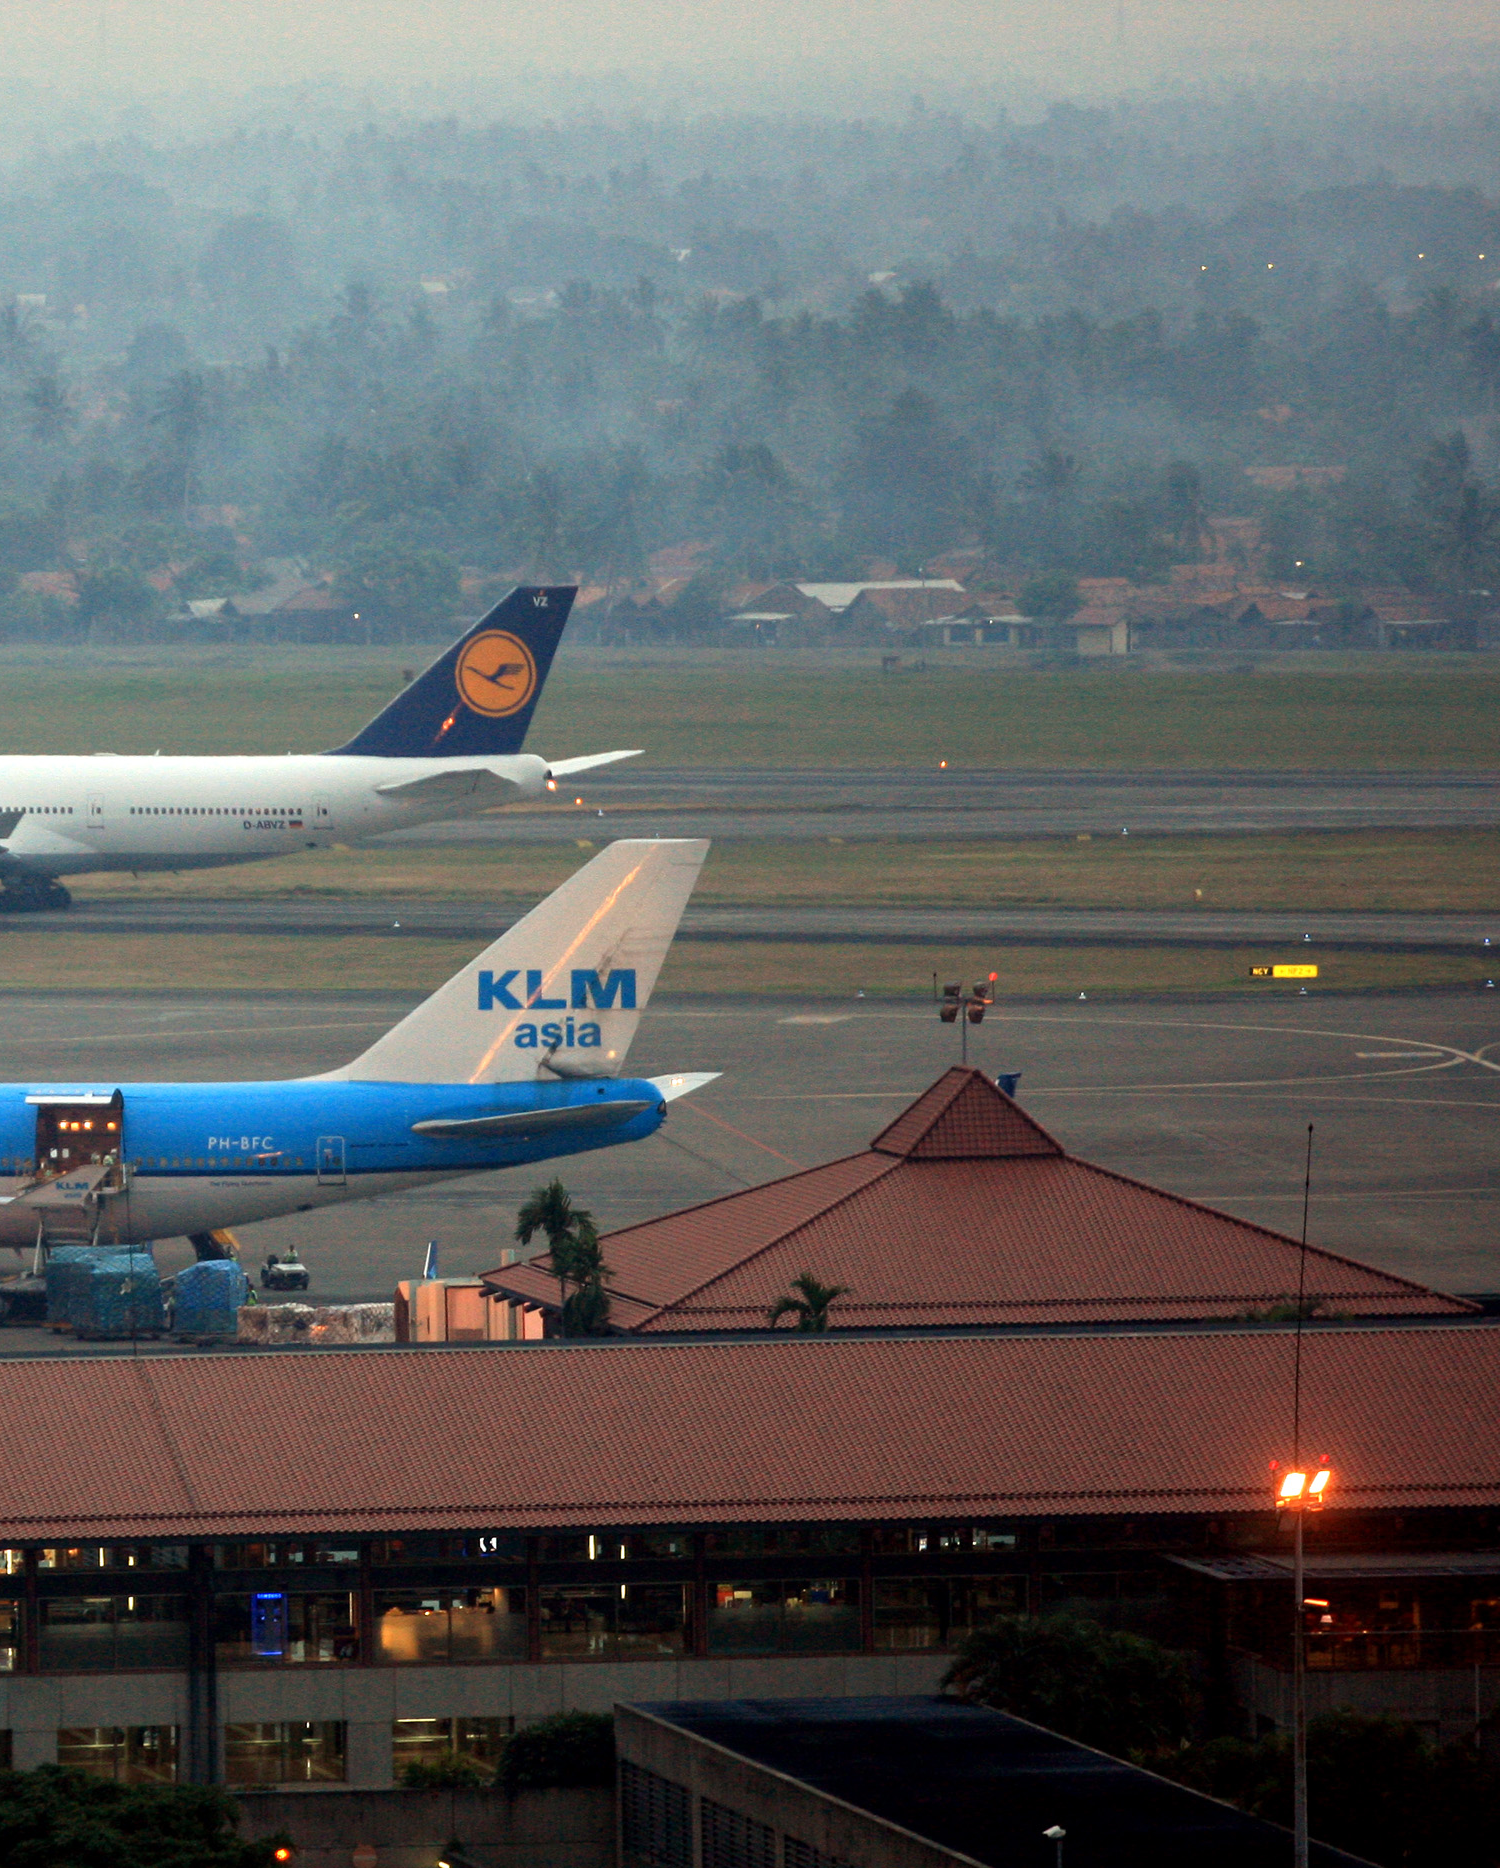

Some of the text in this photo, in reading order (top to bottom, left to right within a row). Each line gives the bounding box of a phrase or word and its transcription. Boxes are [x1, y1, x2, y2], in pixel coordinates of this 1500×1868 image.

[532, 596, 549, 607] VZ
[243, 820, 286, 830] D-ABVZ
[477, 969, 637, 1011] KLM
[514, 1016, 602, 1049] asia
[207, 1136, 274, 1150] PH-BFC
[55, 1181, 89, 1190] KLM
